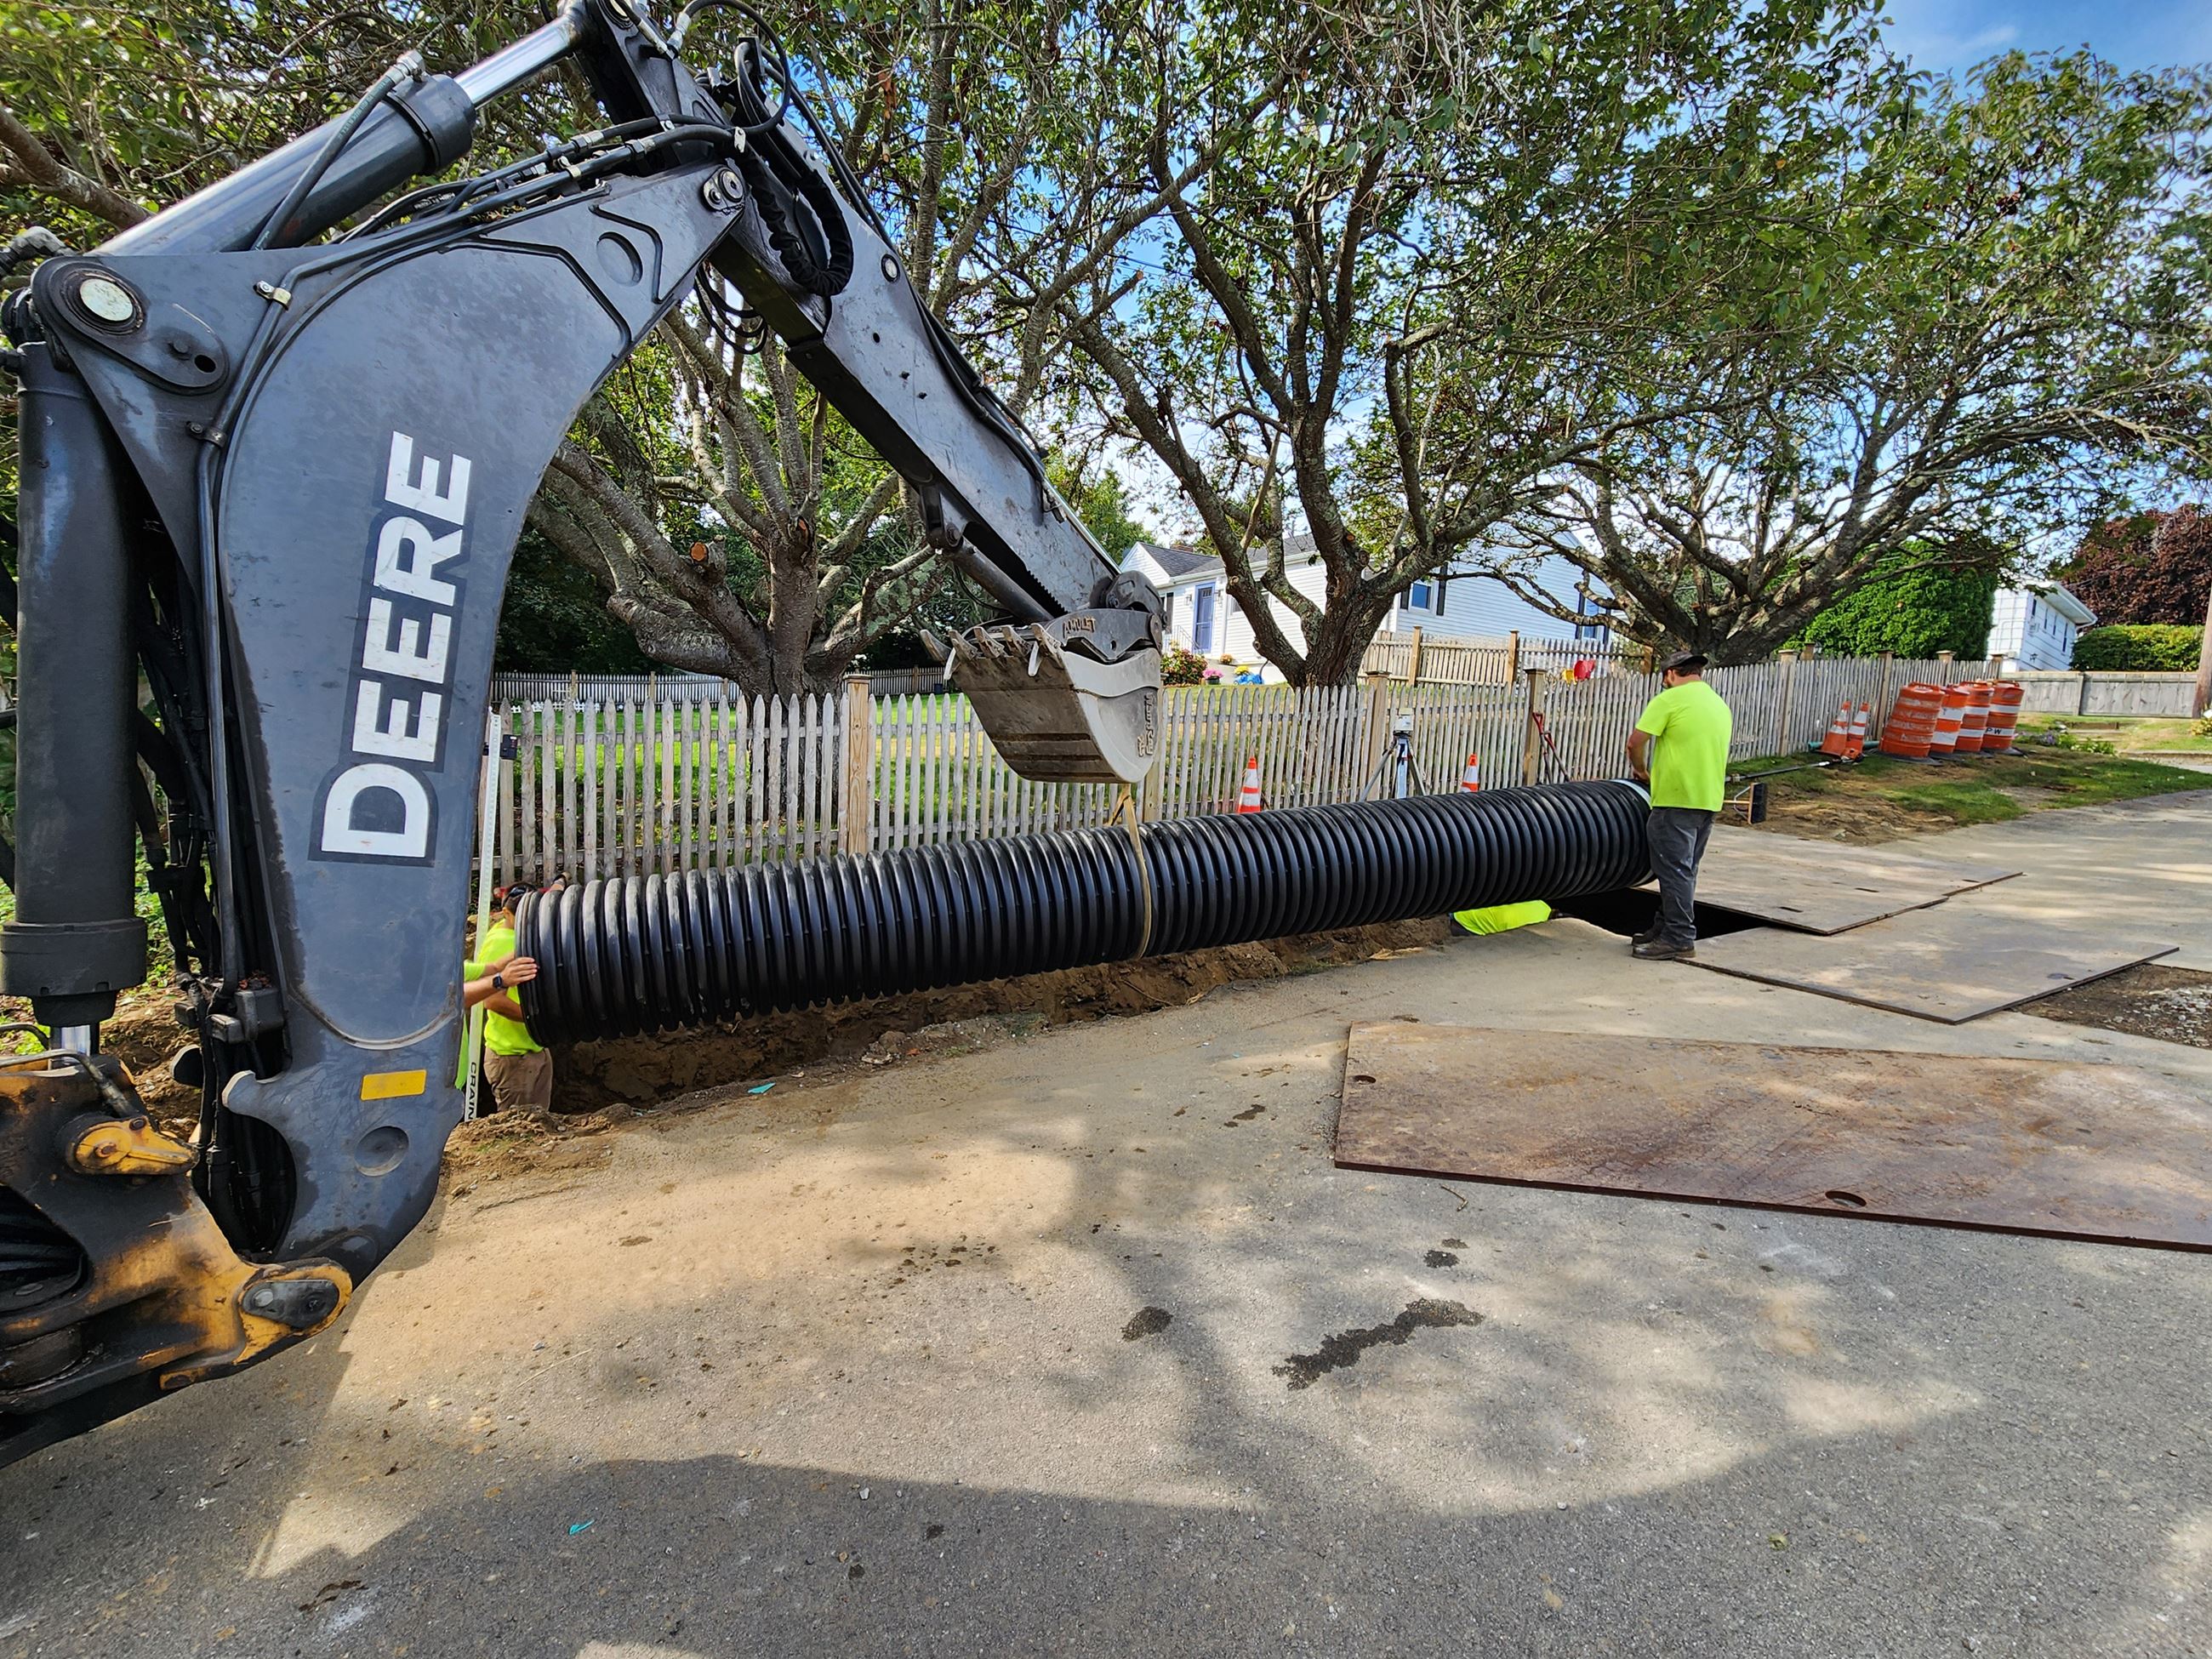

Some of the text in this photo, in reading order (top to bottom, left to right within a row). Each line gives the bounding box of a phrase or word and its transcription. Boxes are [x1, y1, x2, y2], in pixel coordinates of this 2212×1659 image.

[322, 430, 471, 858] DEERE
[1063, 616, 1096, 639] AMULET
[468, 1062, 477, 1120] CRAIN
